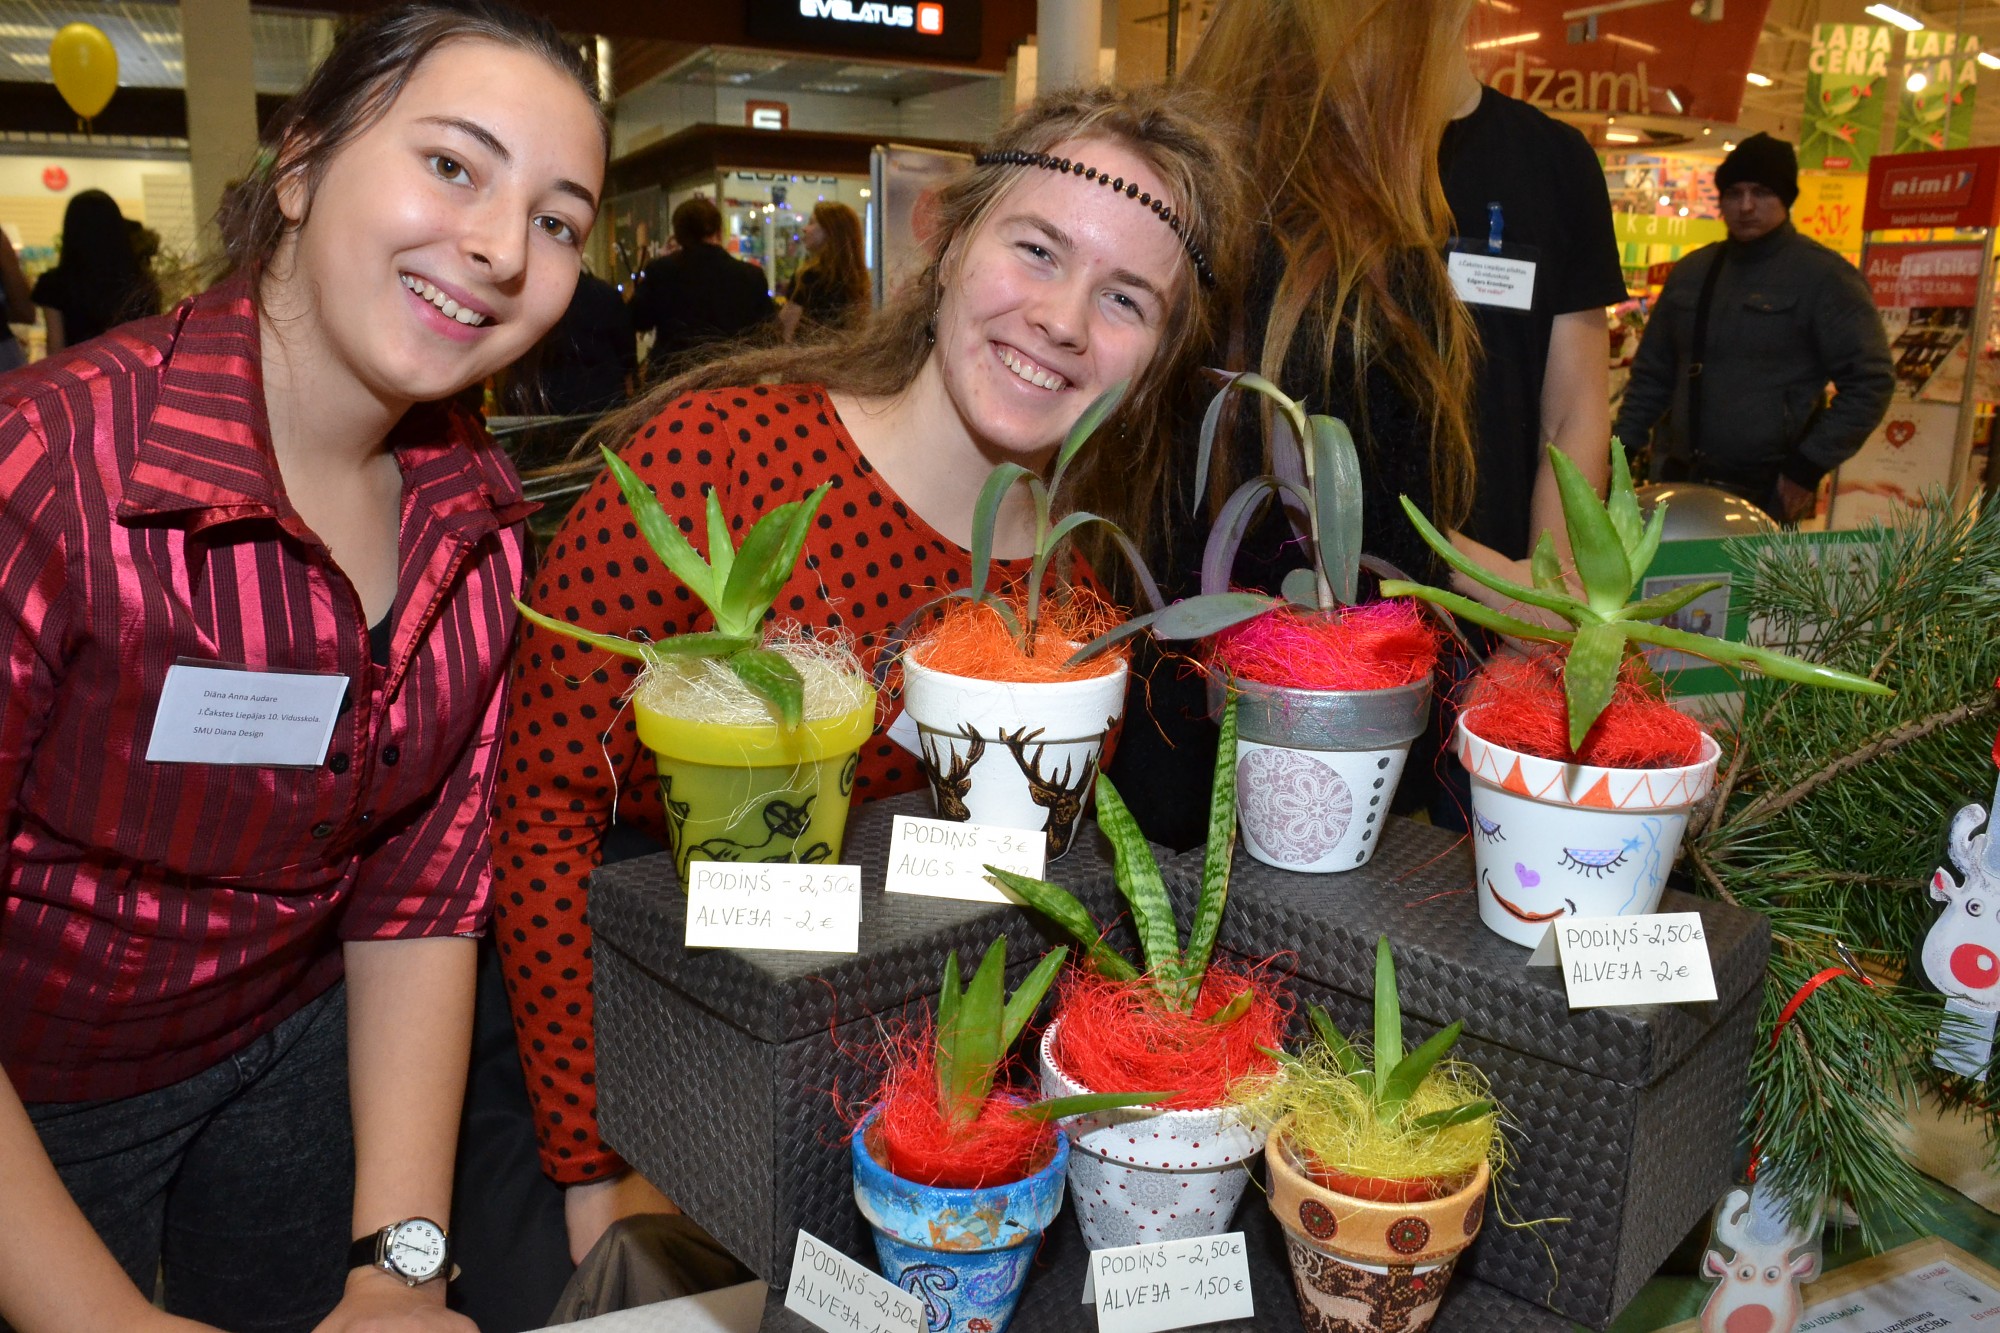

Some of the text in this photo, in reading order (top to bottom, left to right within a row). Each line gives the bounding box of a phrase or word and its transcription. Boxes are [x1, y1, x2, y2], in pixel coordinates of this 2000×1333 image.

[1811, 23, 1891, 52] LABA
[1809, 50, 1888, 77] CENA
[1477, 50, 1650, 114] dzam!
[203, 690, 278, 703] Diāna Anna Audare
[235, 711, 266, 721] Liepājas
[281, 714, 321, 723] Vidusskola.
[193, 726, 264, 738] SMU Diana Design
